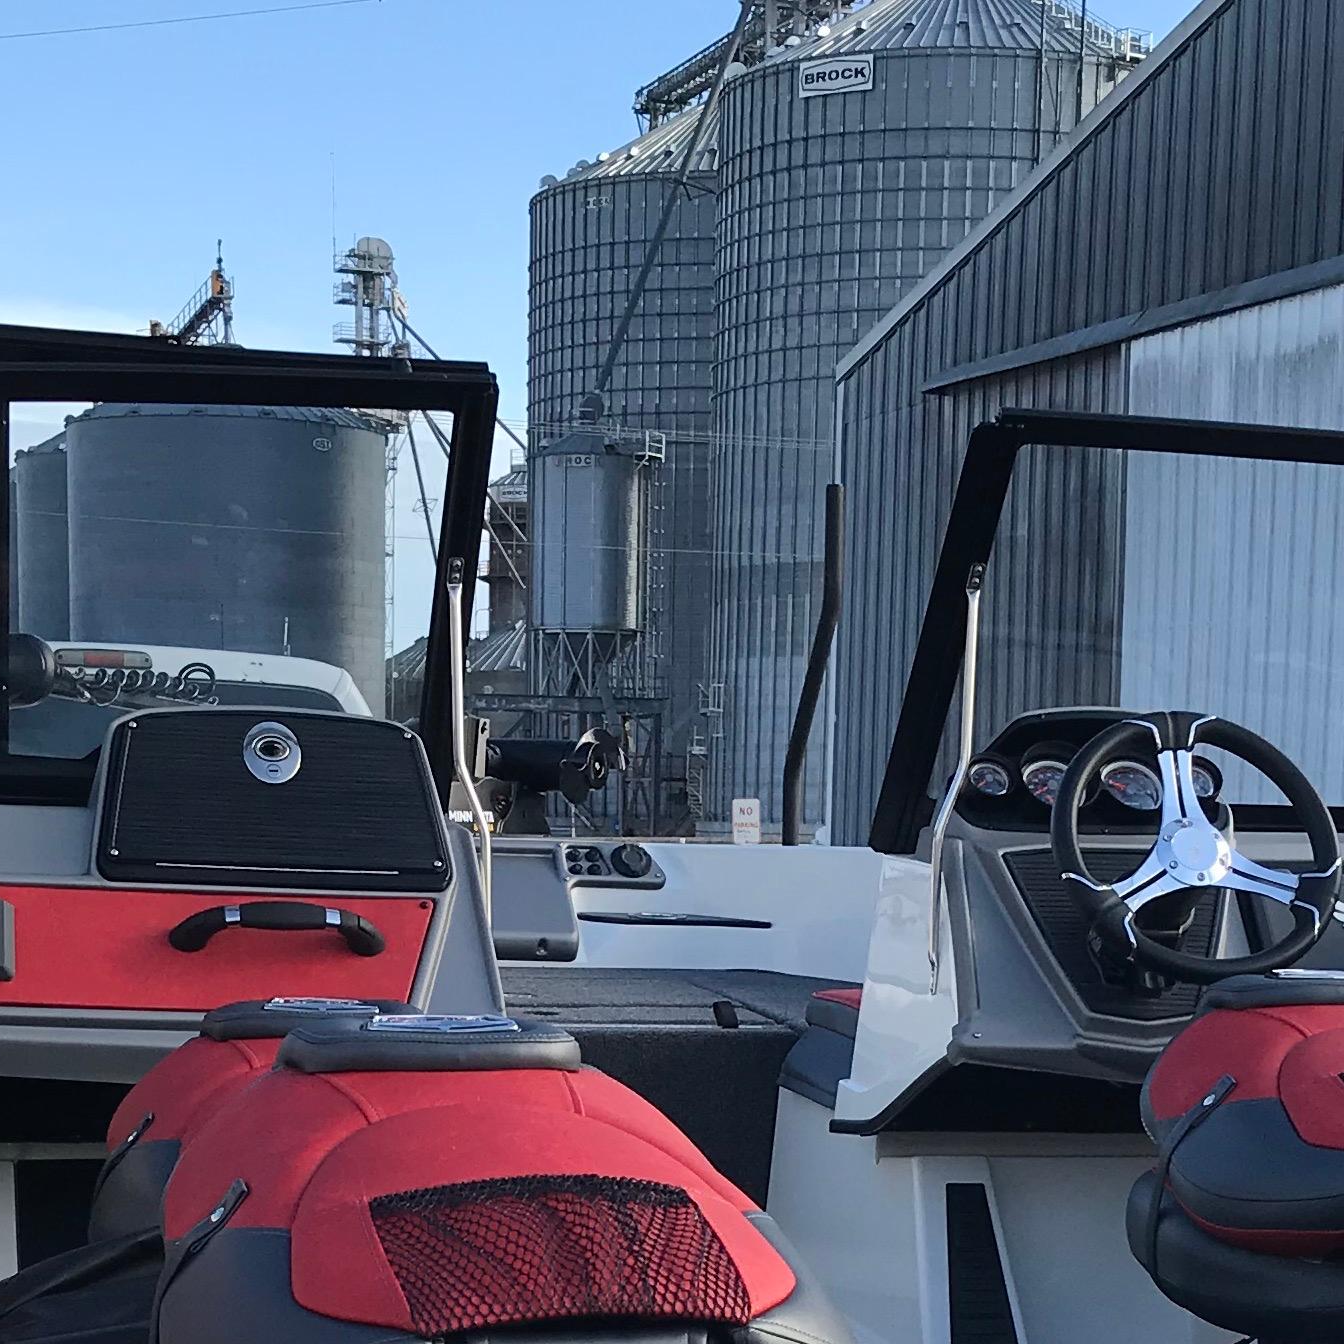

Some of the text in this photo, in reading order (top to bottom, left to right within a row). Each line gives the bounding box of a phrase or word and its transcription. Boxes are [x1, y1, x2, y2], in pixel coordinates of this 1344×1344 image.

[805, 67, 866, 84] BROCK
[449, 811, 473, 822] MINN
[739, 807, 753, 816] NO
